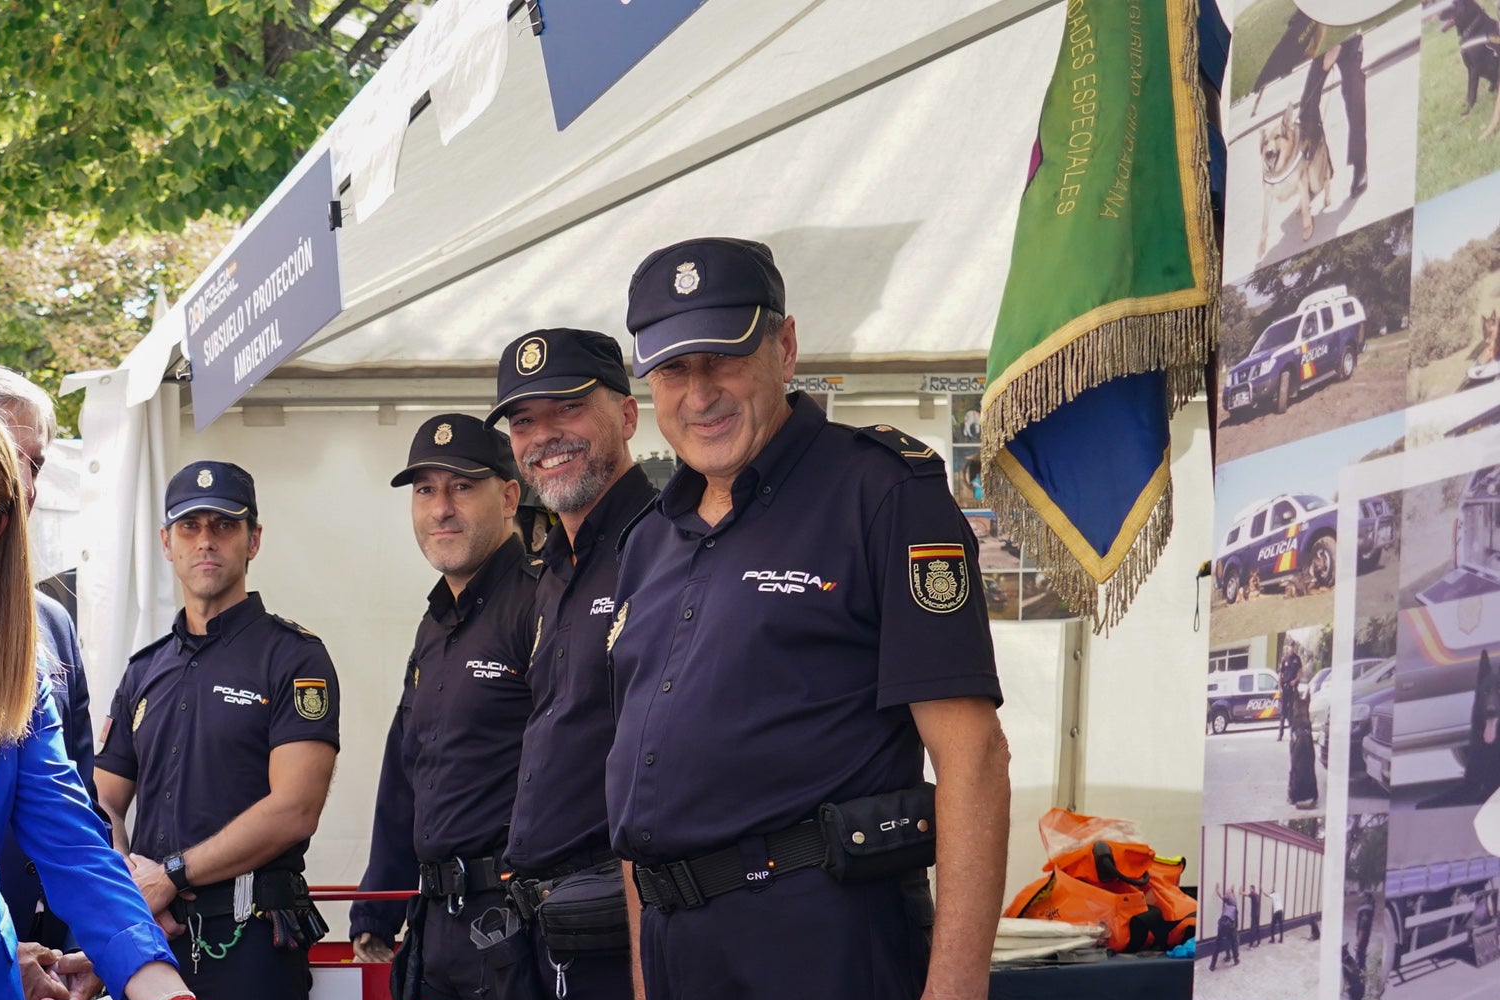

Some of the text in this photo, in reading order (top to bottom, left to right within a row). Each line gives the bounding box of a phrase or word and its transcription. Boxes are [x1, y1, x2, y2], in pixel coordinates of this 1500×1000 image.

[1056, 73, 1097, 216] ESPECIALES
[203, 236, 314, 367] SUBSUELO Y PROTECCIÓN
[233, 318, 283, 385] AMBIENTAL
[930, 376, 979, 386] POLICIA
[930, 384, 986, 392] NACIONA
[741, 570, 823, 588] POLICIA
[757, 582, 806, 594] CNP
[465, 660, 510, 672] POLICIA
[473, 669, 501, 679] CNP
[213, 685, 263, 703] POLICIA
[223, 694, 253, 706] CNP
[879, 818, 910, 832] CNP
[746, 870, 770, 881] CNP
